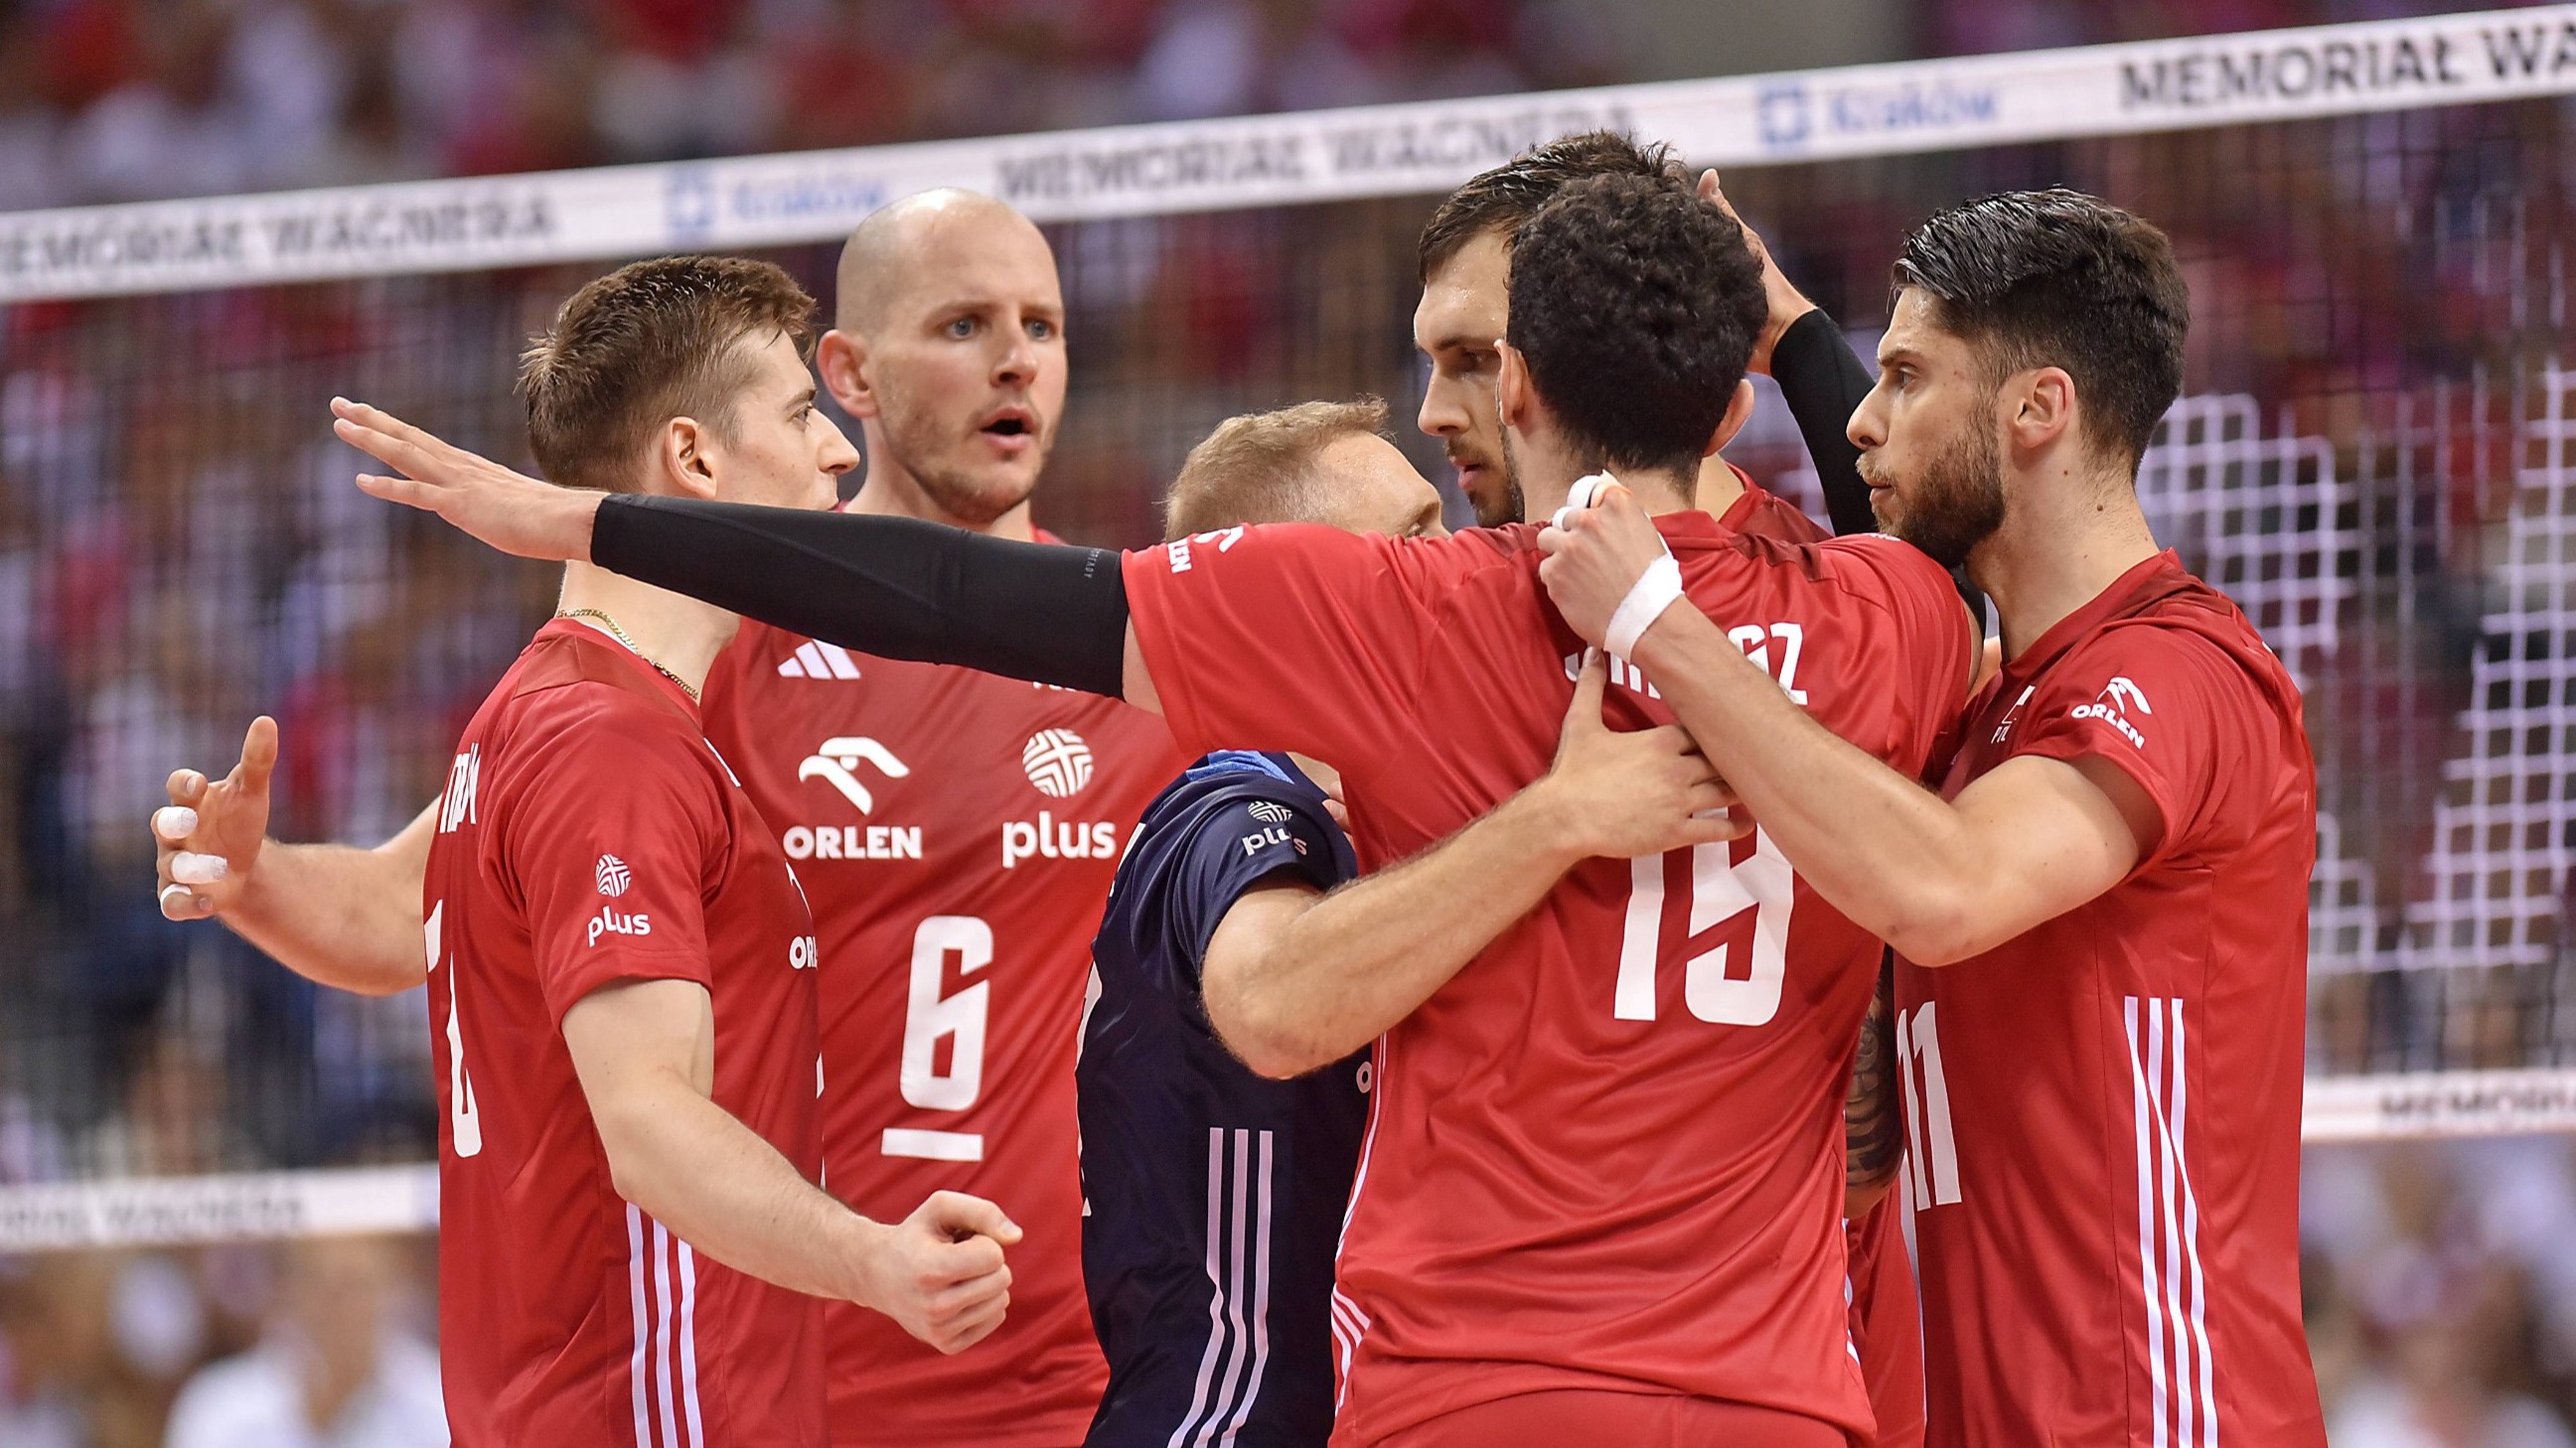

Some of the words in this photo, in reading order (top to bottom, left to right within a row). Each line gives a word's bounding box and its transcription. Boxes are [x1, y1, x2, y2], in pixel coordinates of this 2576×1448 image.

[2120, 34, 2463, 108] MEMORIAŁ
[0, 217, 245, 274] EMORIAŁ
[2070, 702, 2146, 750] ORLEN
[783, 825, 922, 860] ORLEN
[1002, 810, 1117, 869] plus
[1242, 826, 1307, 857] plus
[587, 905, 652, 947] plus
[1613, 806, 1794, 1027] 19
[899, 915, 993, 1112] 6
[1896, 1000, 1963, 1212] 11
